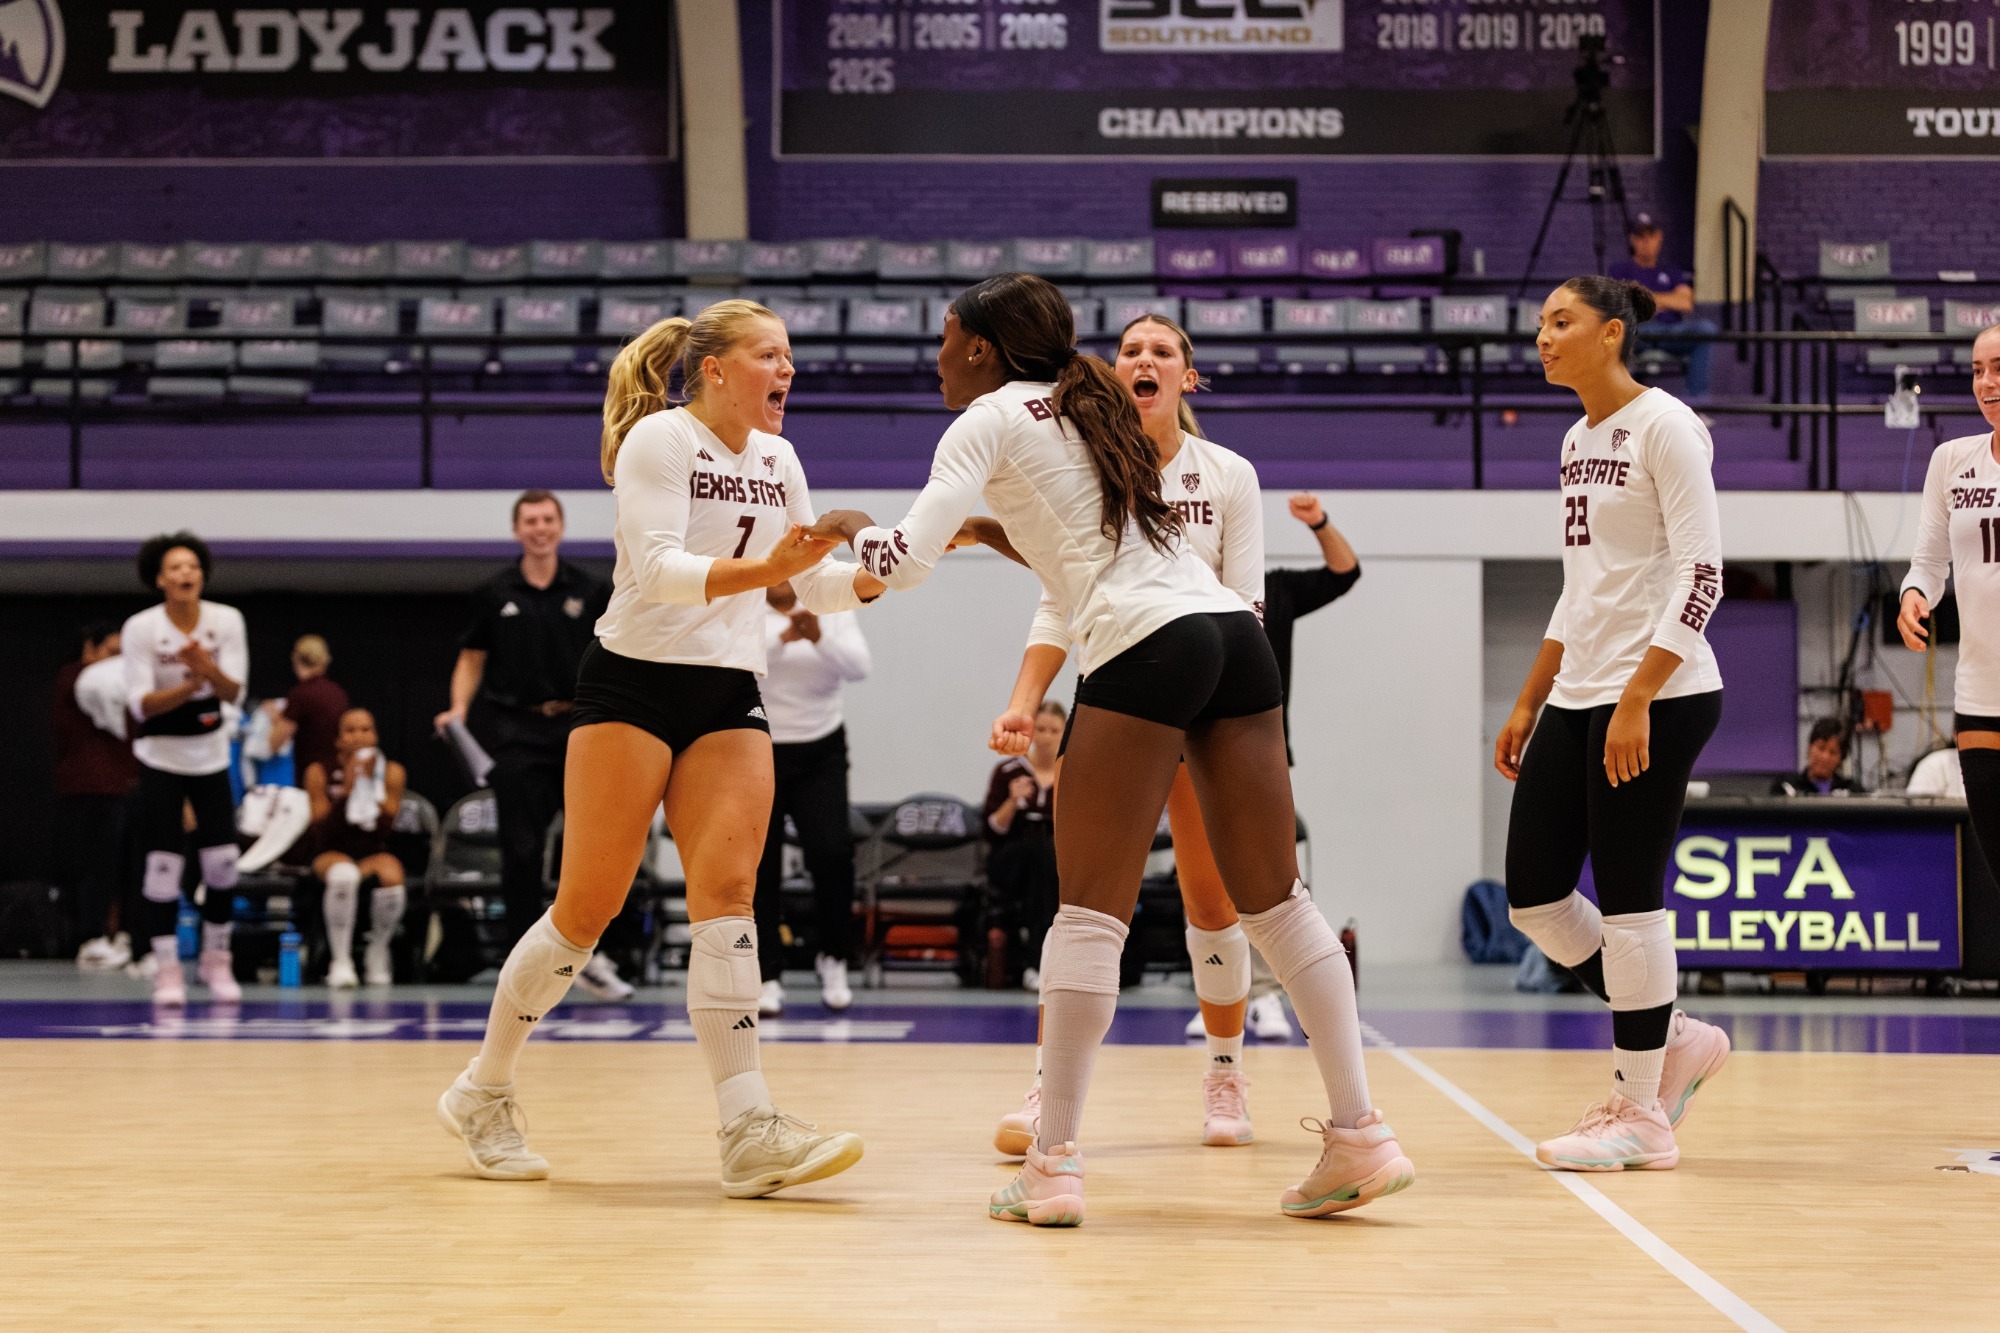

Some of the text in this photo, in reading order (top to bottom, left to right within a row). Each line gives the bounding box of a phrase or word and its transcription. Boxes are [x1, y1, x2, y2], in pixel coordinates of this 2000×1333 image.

[914, 13, 981, 48] 2005
[1107, 26, 1313, 44] SOUTHLAND
[1377, 13, 1438, 49] 2018
[1457, 13, 1519, 49] 2019
[1895, 20, 1976, 66] 1999
[828, 57, 896, 94] 2025
[1099, 107, 1345, 138] CHAMPIONS
[1161, 190, 1288, 214] RESERVED
[1583, 458, 1630, 487] STATE
[748, 478, 786, 508] STAT
[732, 515, 756, 559] 7
[1565, 495, 1591, 546] 23
[1680, 591, 1712, 633] EAT
[1674, 835, 1855, 899] SFA
[1666, 910, 1941, 951] LLEYBALL
